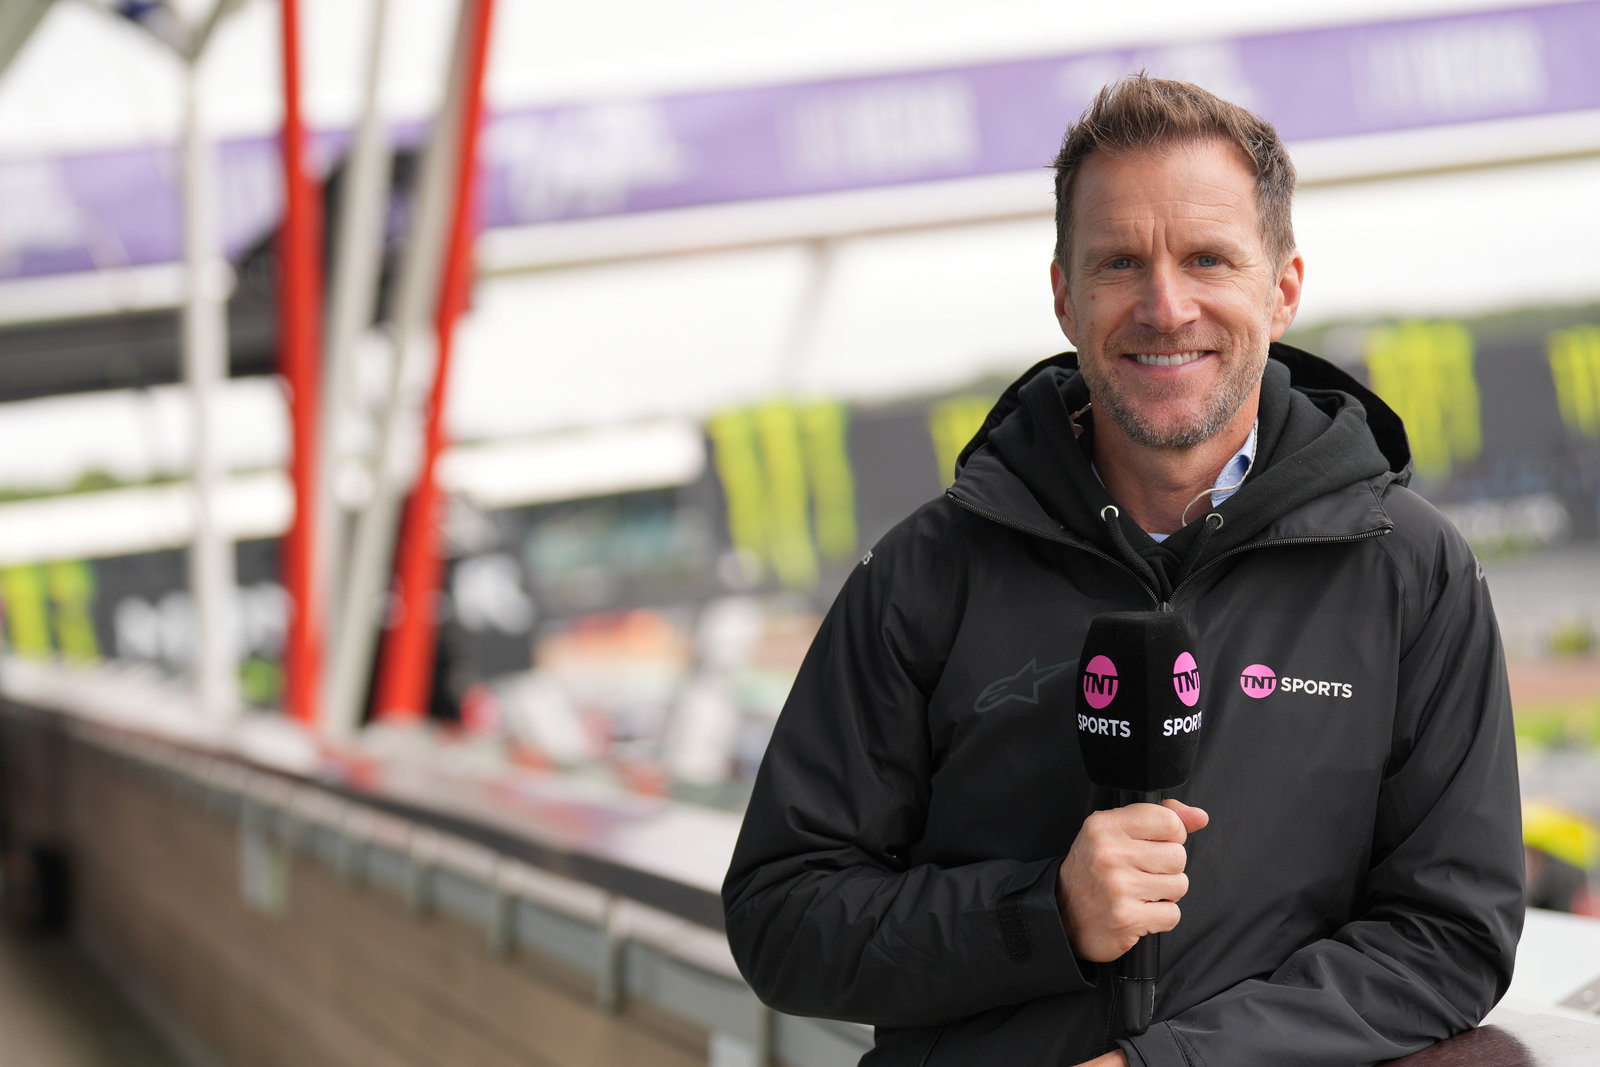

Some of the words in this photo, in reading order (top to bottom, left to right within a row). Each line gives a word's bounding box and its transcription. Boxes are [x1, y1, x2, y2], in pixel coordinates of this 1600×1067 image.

[1084, 671, 1119, 697] TNT
[1240, 673, 1277, 691] TNT
[1280, 677, 1353, 699] SPORTS
[1078, 713, 1131, 738] SPORTS
[1163, 711, 1202, 736] SPORT
